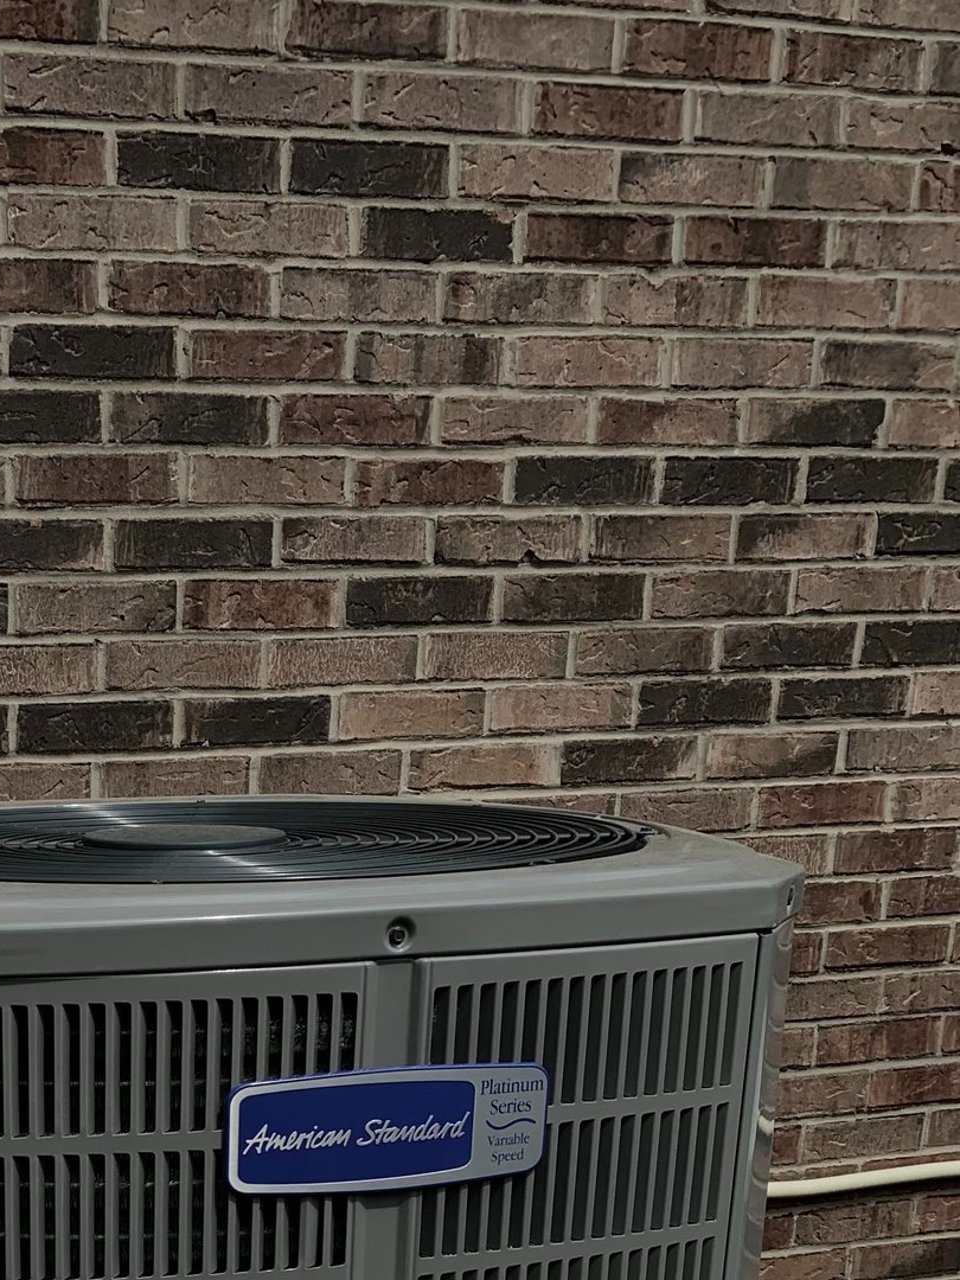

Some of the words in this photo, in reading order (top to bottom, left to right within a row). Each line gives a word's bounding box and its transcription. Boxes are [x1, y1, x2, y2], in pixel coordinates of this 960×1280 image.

[480, 1077, 545, 1096] Platinum
[489, 1097, 533, 1116] Series
[242, 1123, 352, 1156] American
[354, 1110, 471, 1147] Standard
[486, 1131, 531, 1147] Variable
[490, 1149, 525, 1165] Speed
